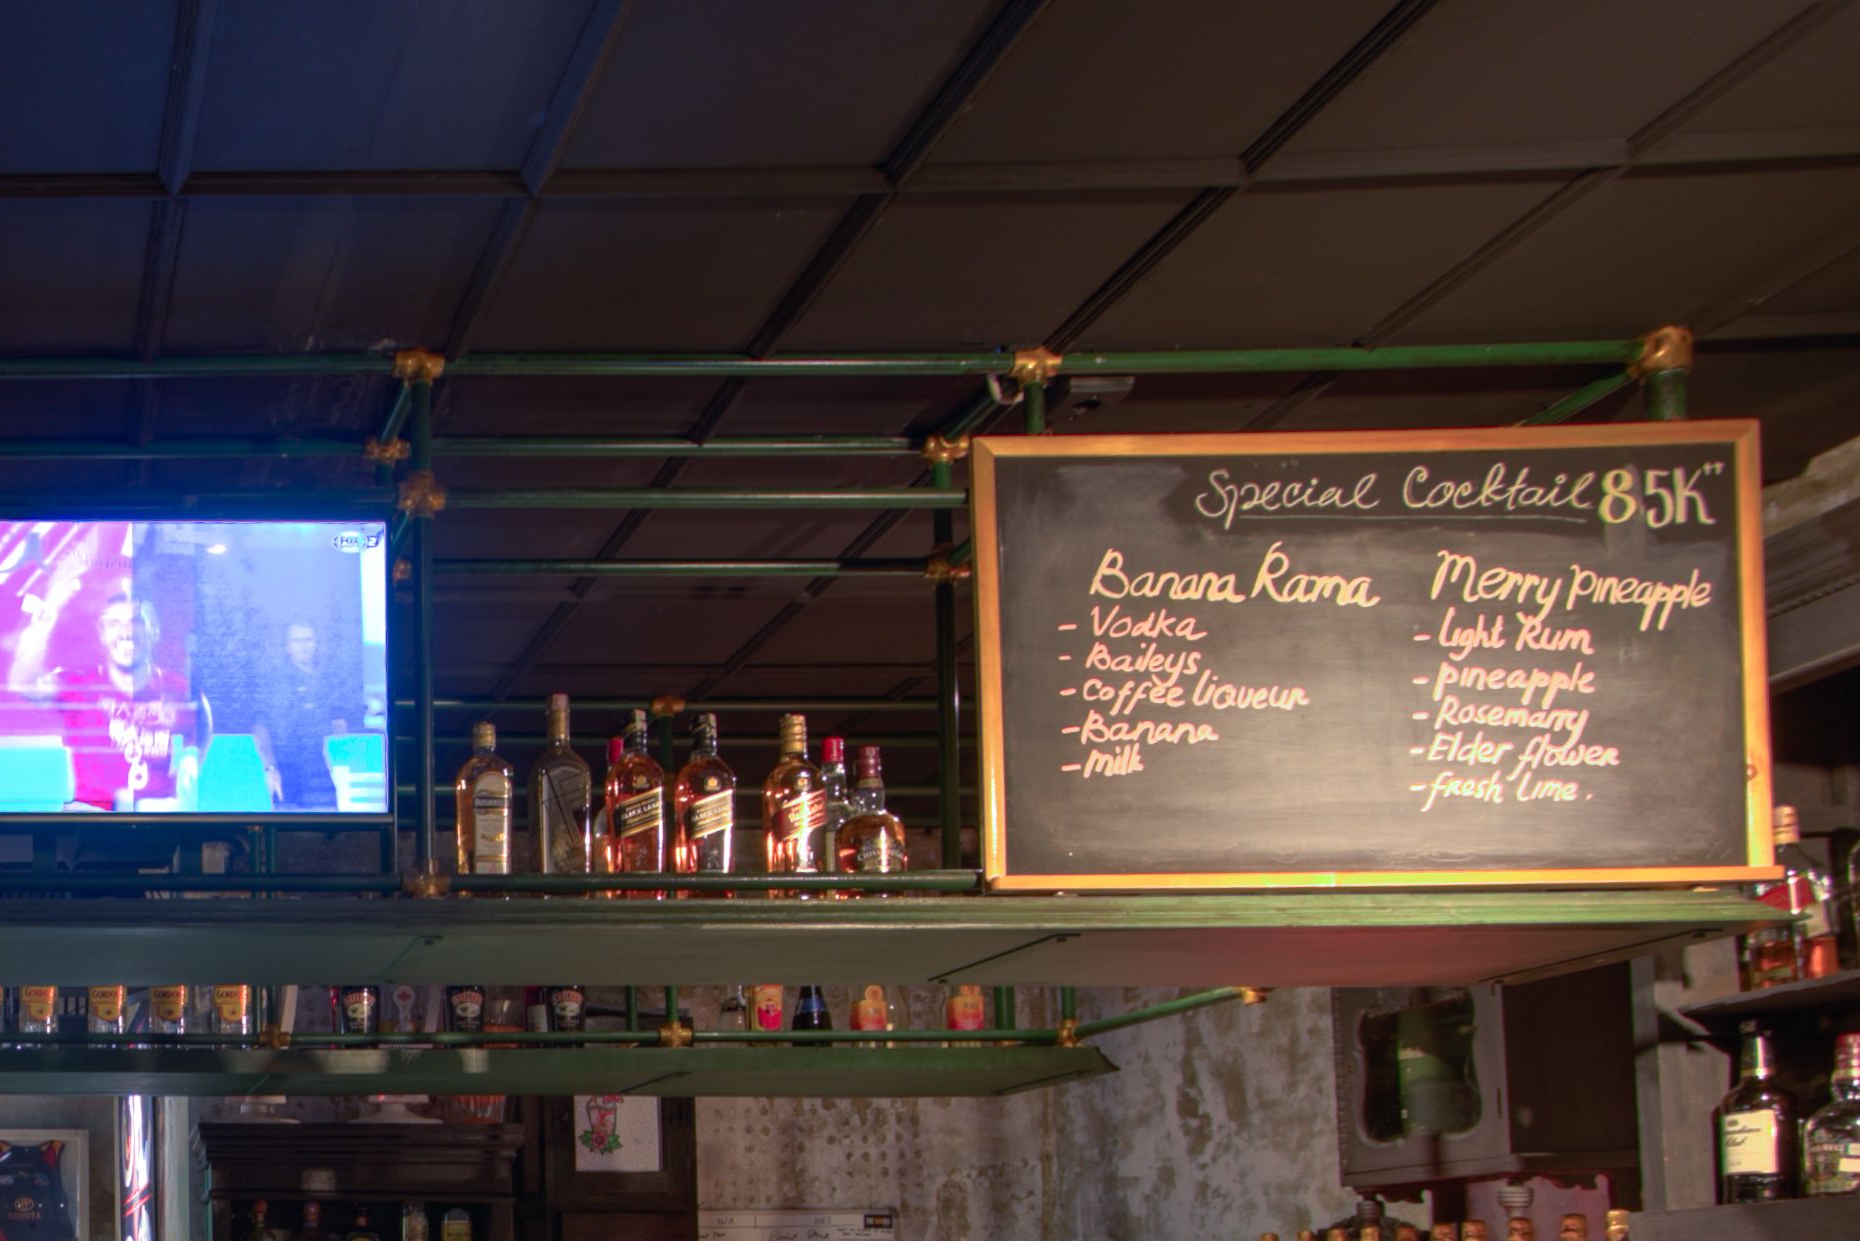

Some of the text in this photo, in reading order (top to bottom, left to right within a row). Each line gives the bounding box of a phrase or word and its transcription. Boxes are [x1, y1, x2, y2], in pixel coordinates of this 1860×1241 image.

[1196, 469, 1379, 530] Special
[1403, 462, 1596, 510] Cocktail
[1090, 540, 1380, 607] Banana Rama
[1431, 550, 1563, 622] Merry
[1090, 605, 1207, 640] Vodka
[1516, 612, 1594, 654] Rum
[1085, 642, 1201, 687] Baileys
[1083, 675, 1185, 716] Coffee
[1081, 709, 1219, 744] Banana
[1434, 695, 1589, 750] Rosemarry
[1427, 731, 1620, 782] Elder flower
[1421, 770, 1503, 812] fresh
[7, 1211, 43, 1221] TOYOTA
